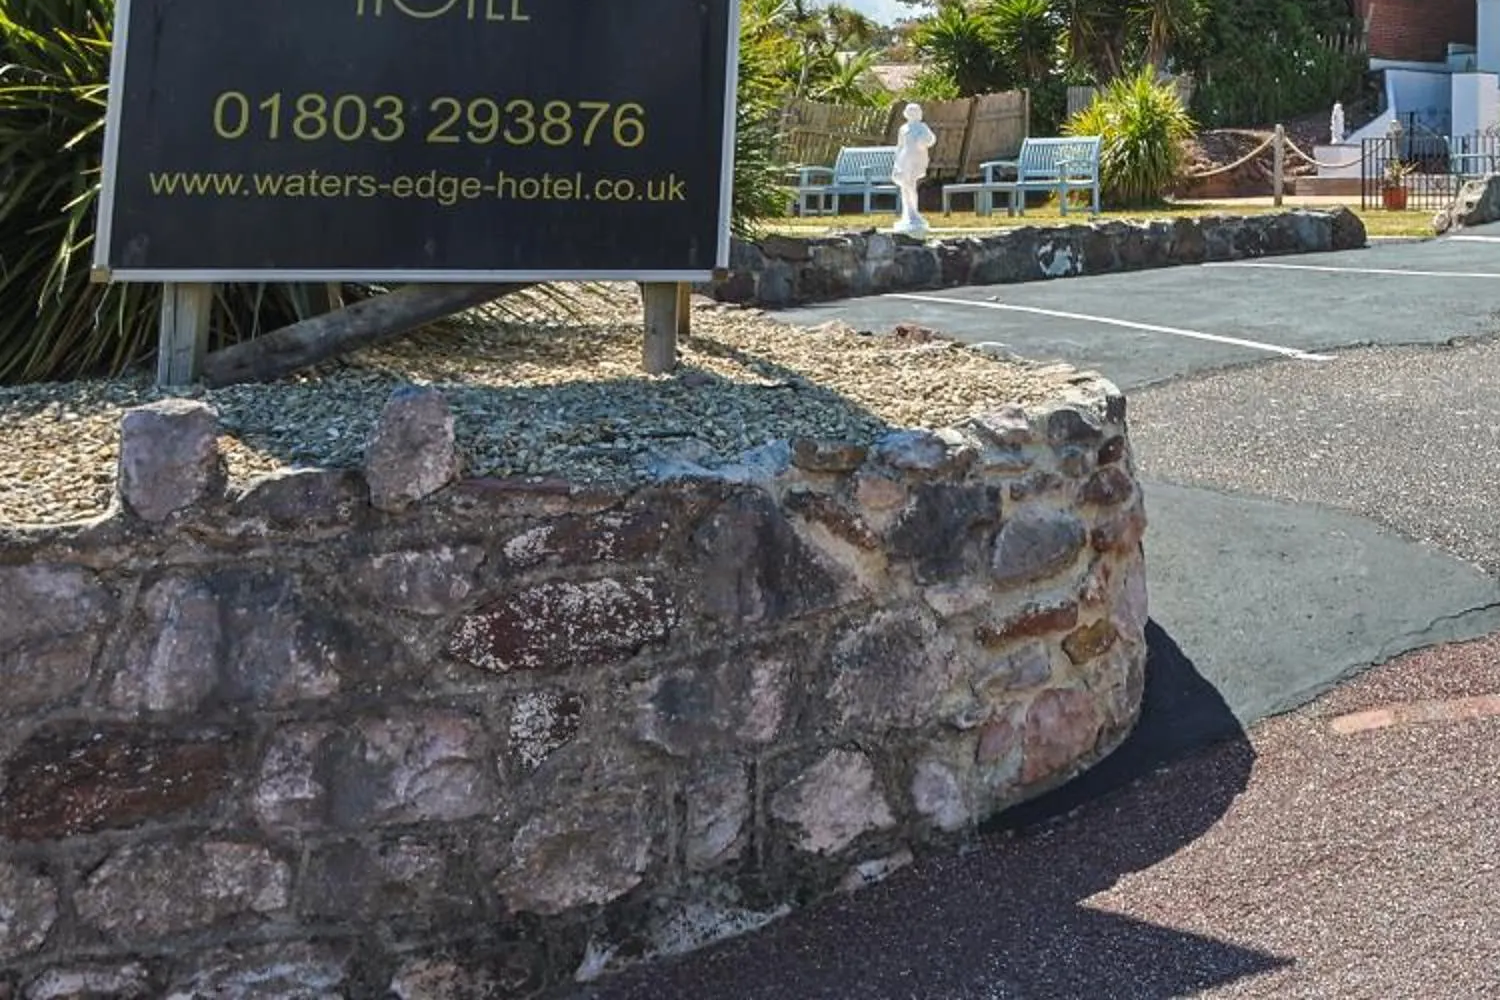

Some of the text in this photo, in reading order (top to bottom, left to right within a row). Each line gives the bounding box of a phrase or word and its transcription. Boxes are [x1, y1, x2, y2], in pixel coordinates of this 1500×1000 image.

[212, 91, 646, 148] 01803 293876
[149, 168, 686, 205] www.waters-edge-hotel.co.uk
